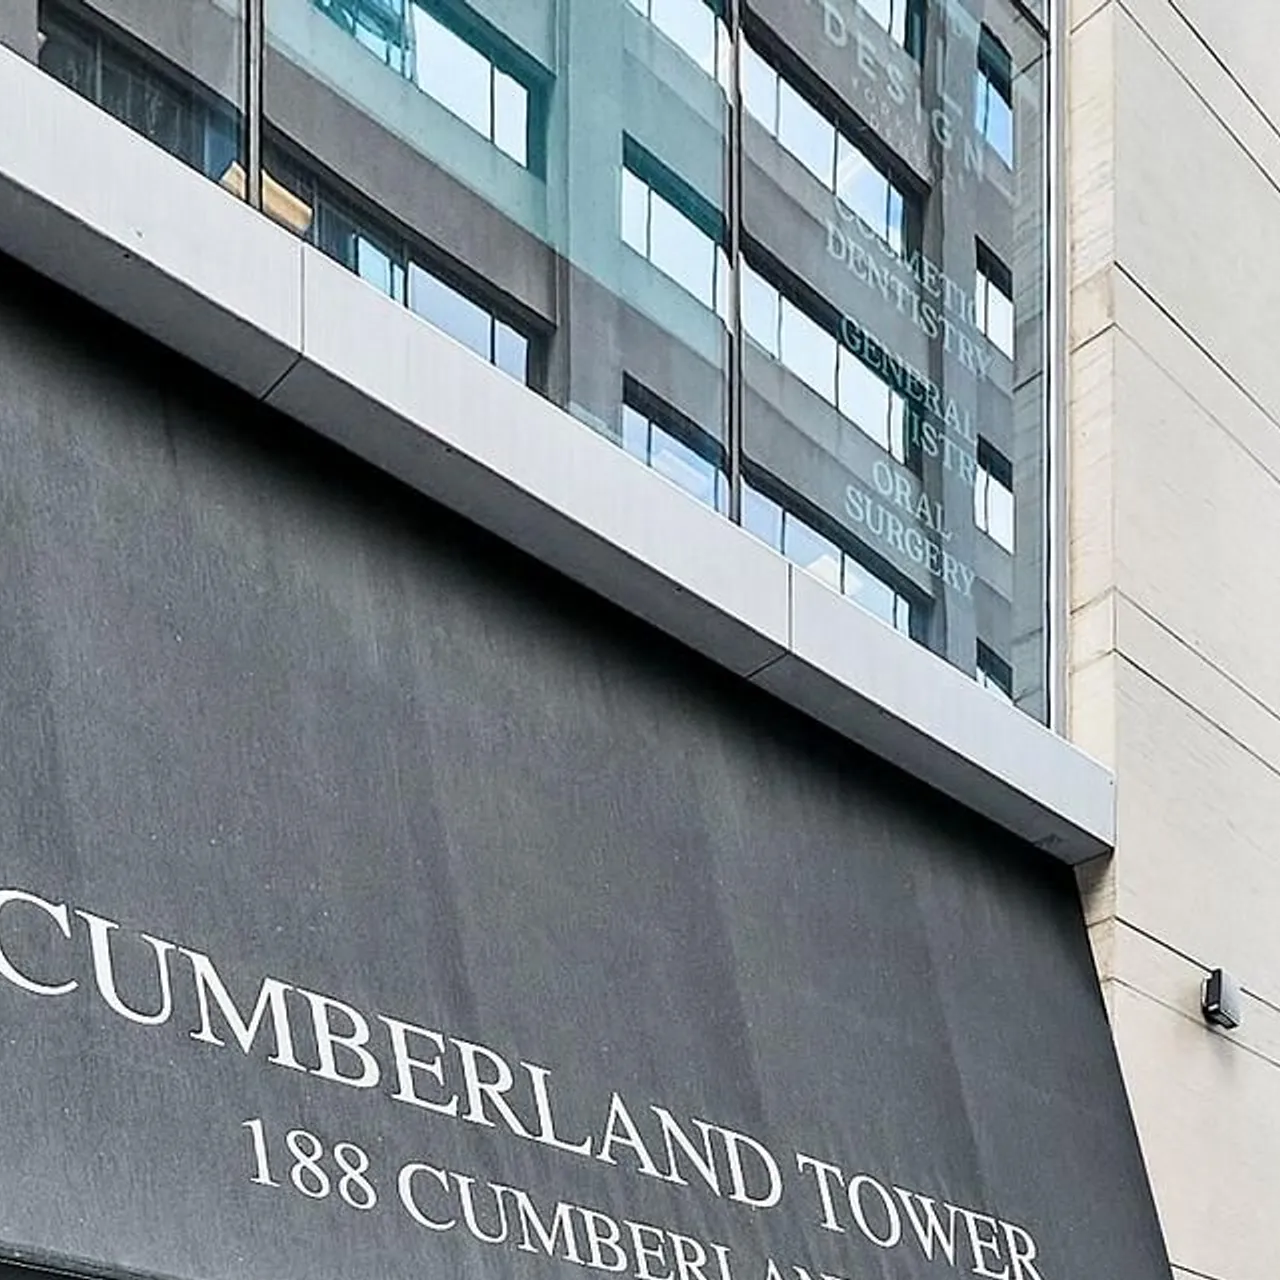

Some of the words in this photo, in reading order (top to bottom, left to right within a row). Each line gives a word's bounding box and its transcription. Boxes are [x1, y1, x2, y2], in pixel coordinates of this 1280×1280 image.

[824, 218, 995, 381] DENTISTRY
[839, 316, 975, 441] GENERAL
[845, 484, 975, 598] SURGERY
[873, 460, 953, 542] ORAL
[242, 1118, 378, 1210] 188
